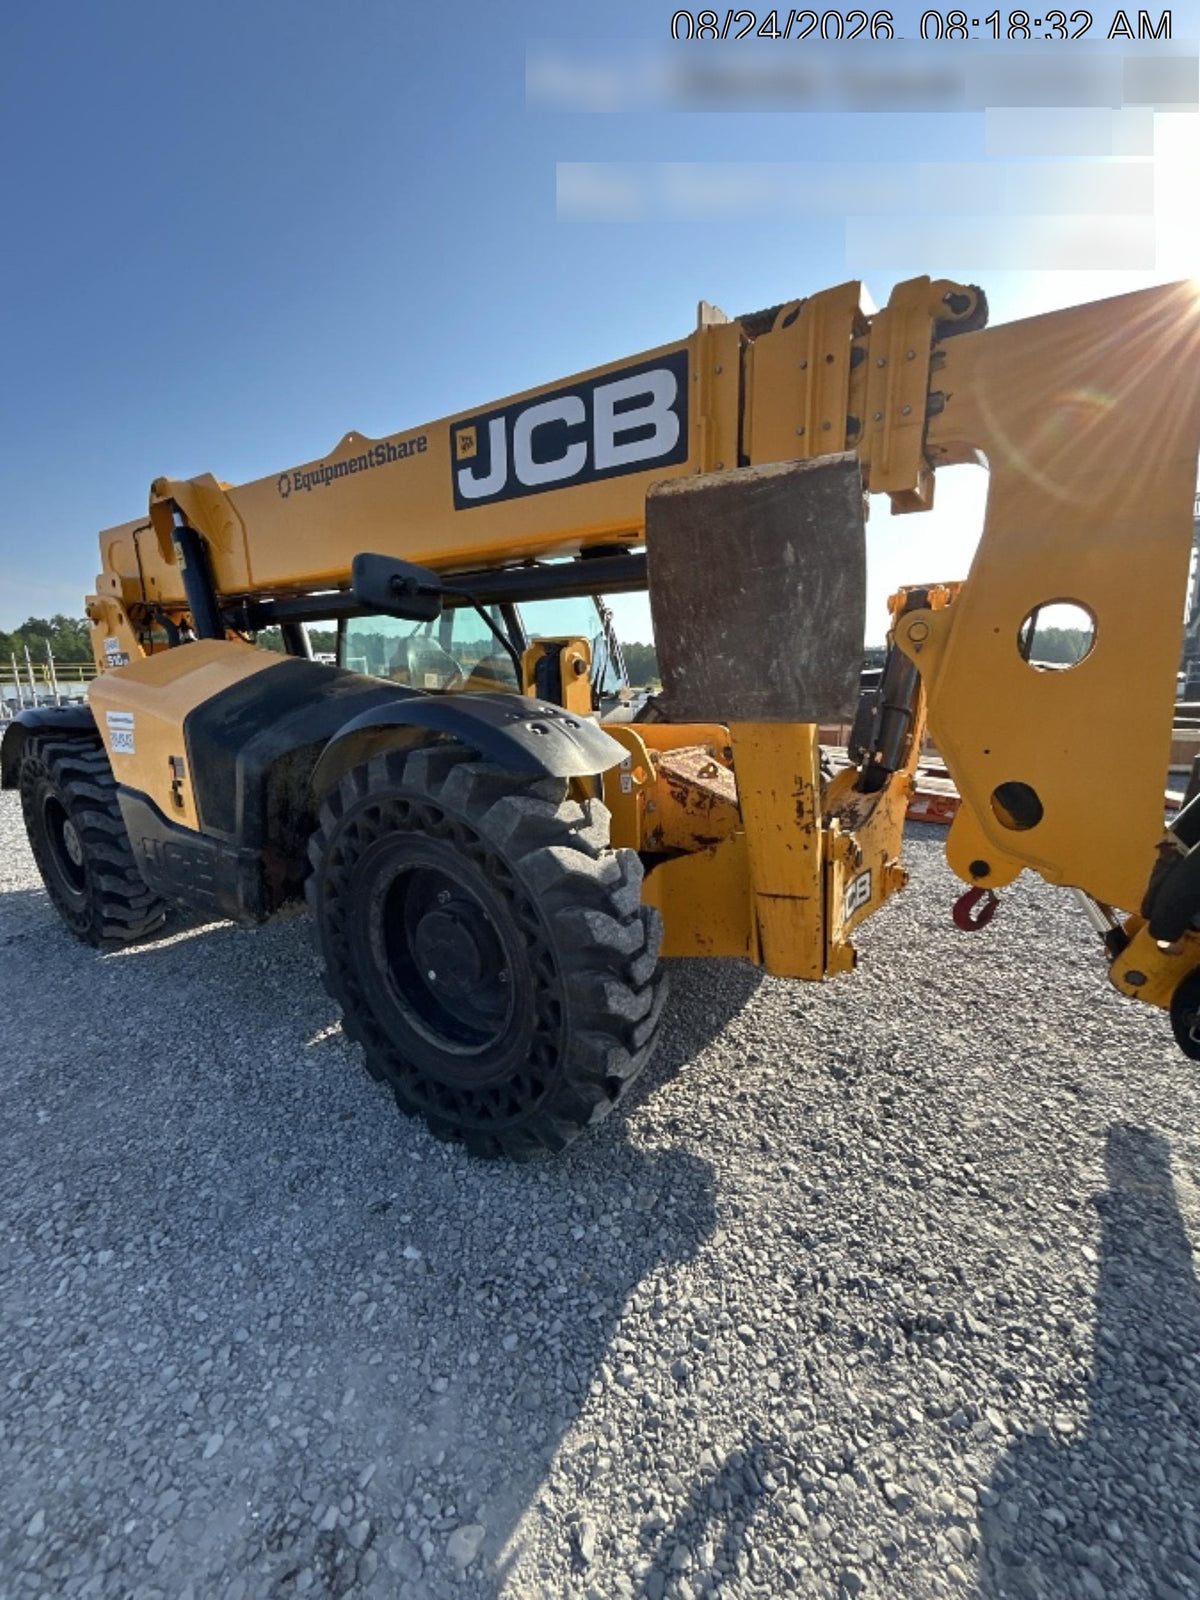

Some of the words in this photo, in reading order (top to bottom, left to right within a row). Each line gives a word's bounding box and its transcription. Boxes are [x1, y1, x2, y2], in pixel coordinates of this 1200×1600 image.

[457, 368, 680, 499] JCB
[293, 435, 428, 491] EquipmentShare
[845, 872, 870, 919] CB
